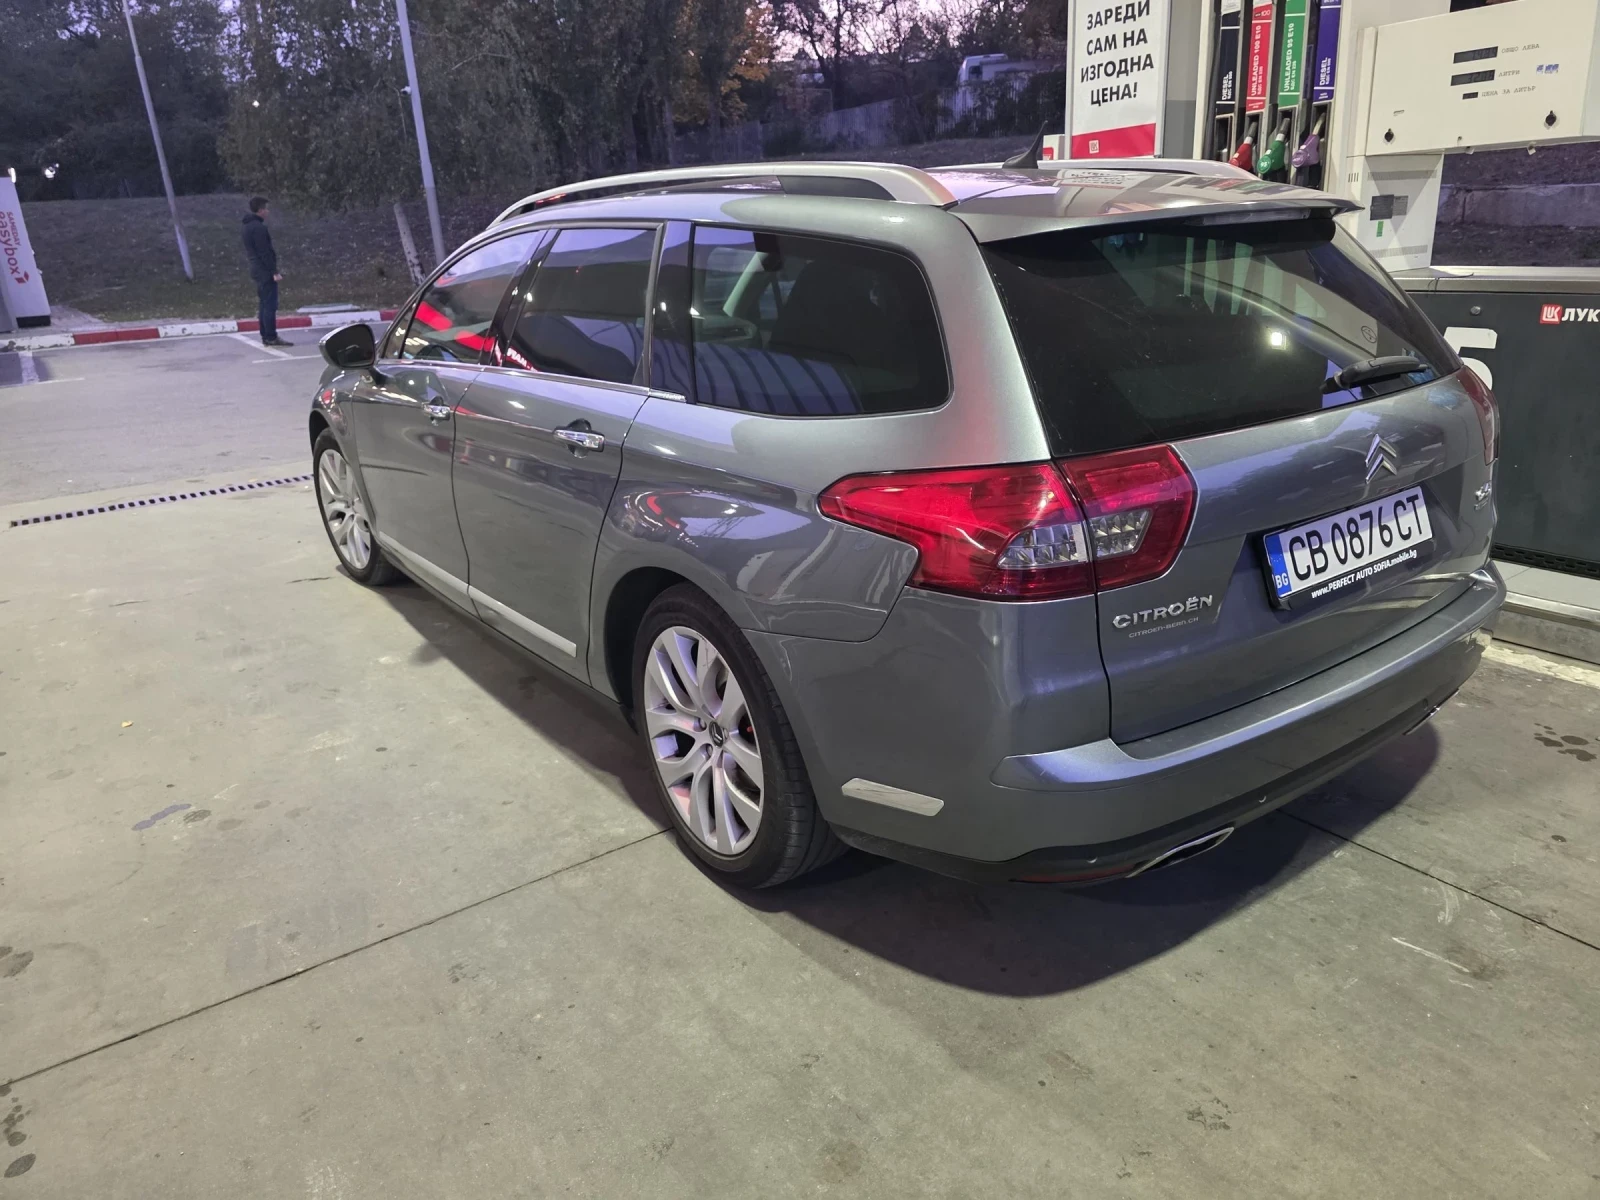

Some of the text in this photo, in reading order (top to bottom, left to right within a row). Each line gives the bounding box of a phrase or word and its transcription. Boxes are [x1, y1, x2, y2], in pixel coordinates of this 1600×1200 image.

[1087, 0, 1150, 30] ЗАРЕДИ
[1086, 28, 1148, 55] САМ НА
[1287, 38, 1293, 48] 95
[1522, 43, 1540, 51] ЛЕВА
[1080, 53, 1154, 83] ИЗГОДНА
[1251, 54, 1259, 96] UNLEADED
[1284, 49, 1292, 91] UNLEADED
[1090, 82, 1138, 107] ЦЕНА!
[1221, 73, 1229, 100] DIESEL
[0, 211, 20, 275] easybox
[7, 211, 21, 246] SAMEDAY
[1289, 529, 1329, 581] CB
[1331, 506, 1393, 565] 0876
[1393, 494, 1423, 541] CT
[1276, 572, 1289, 589] BG
[1311, 549, 1417, 599] www.PERFECT AUTO SOFIA.mobile.bg
[1112, 594, 1213, 629] CITROËN
